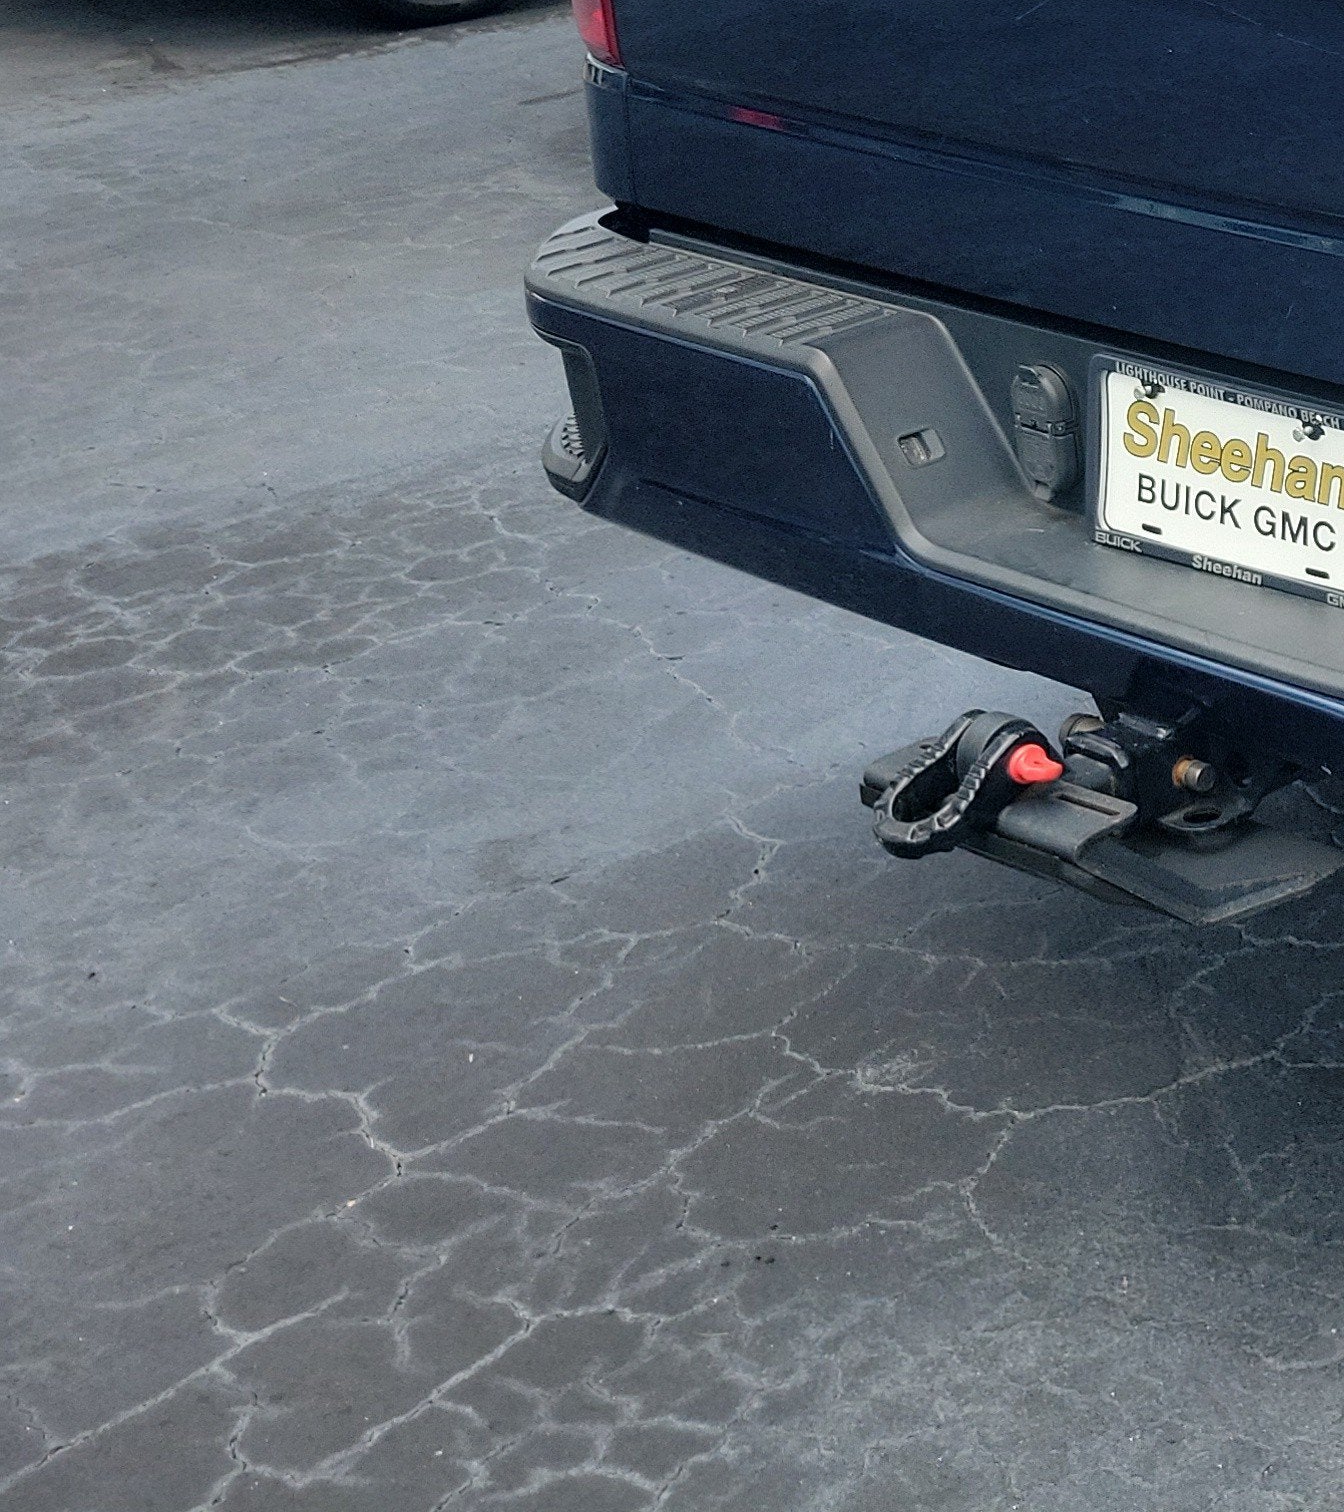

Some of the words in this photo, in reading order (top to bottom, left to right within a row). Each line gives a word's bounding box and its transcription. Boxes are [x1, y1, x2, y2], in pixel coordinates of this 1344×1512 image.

[1115, 361, 1187, 391] LIGHTHOUSE
[1189, 380, 1225, 402] POINT
[1237, 394, 1297, 419] POMPANO
[1138, 473, 1241, 529] BUICK
[1254, 505, 1336, 552] GMC
[1095, 531, 1143, 553] BUICK
[1192, 555, 1262, 585] Sheehan
